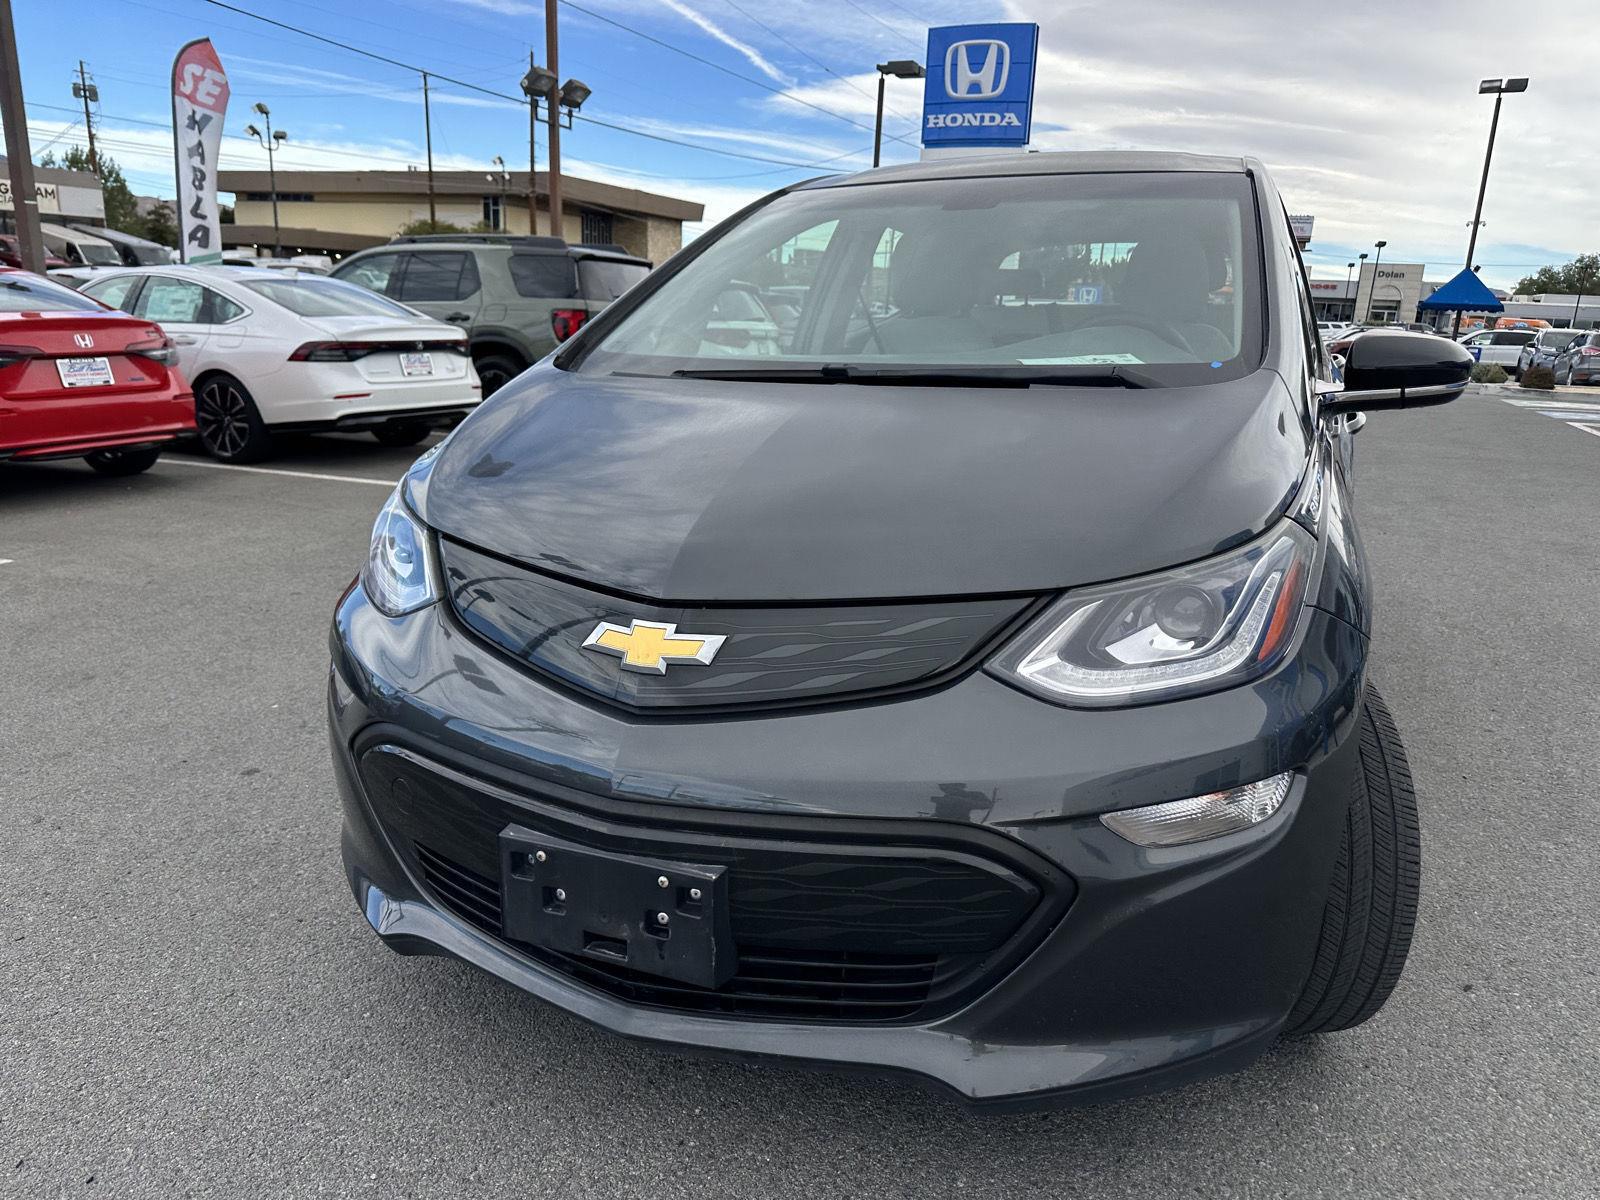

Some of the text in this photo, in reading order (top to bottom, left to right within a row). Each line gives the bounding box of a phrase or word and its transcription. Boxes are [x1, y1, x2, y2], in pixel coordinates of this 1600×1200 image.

[179, 63, 227, 106] SE
[926, 112, 1022, 128] HONDA
[185, 108, 213, 249] HABLA
[1377, 270, 1405, 279] Dolan
